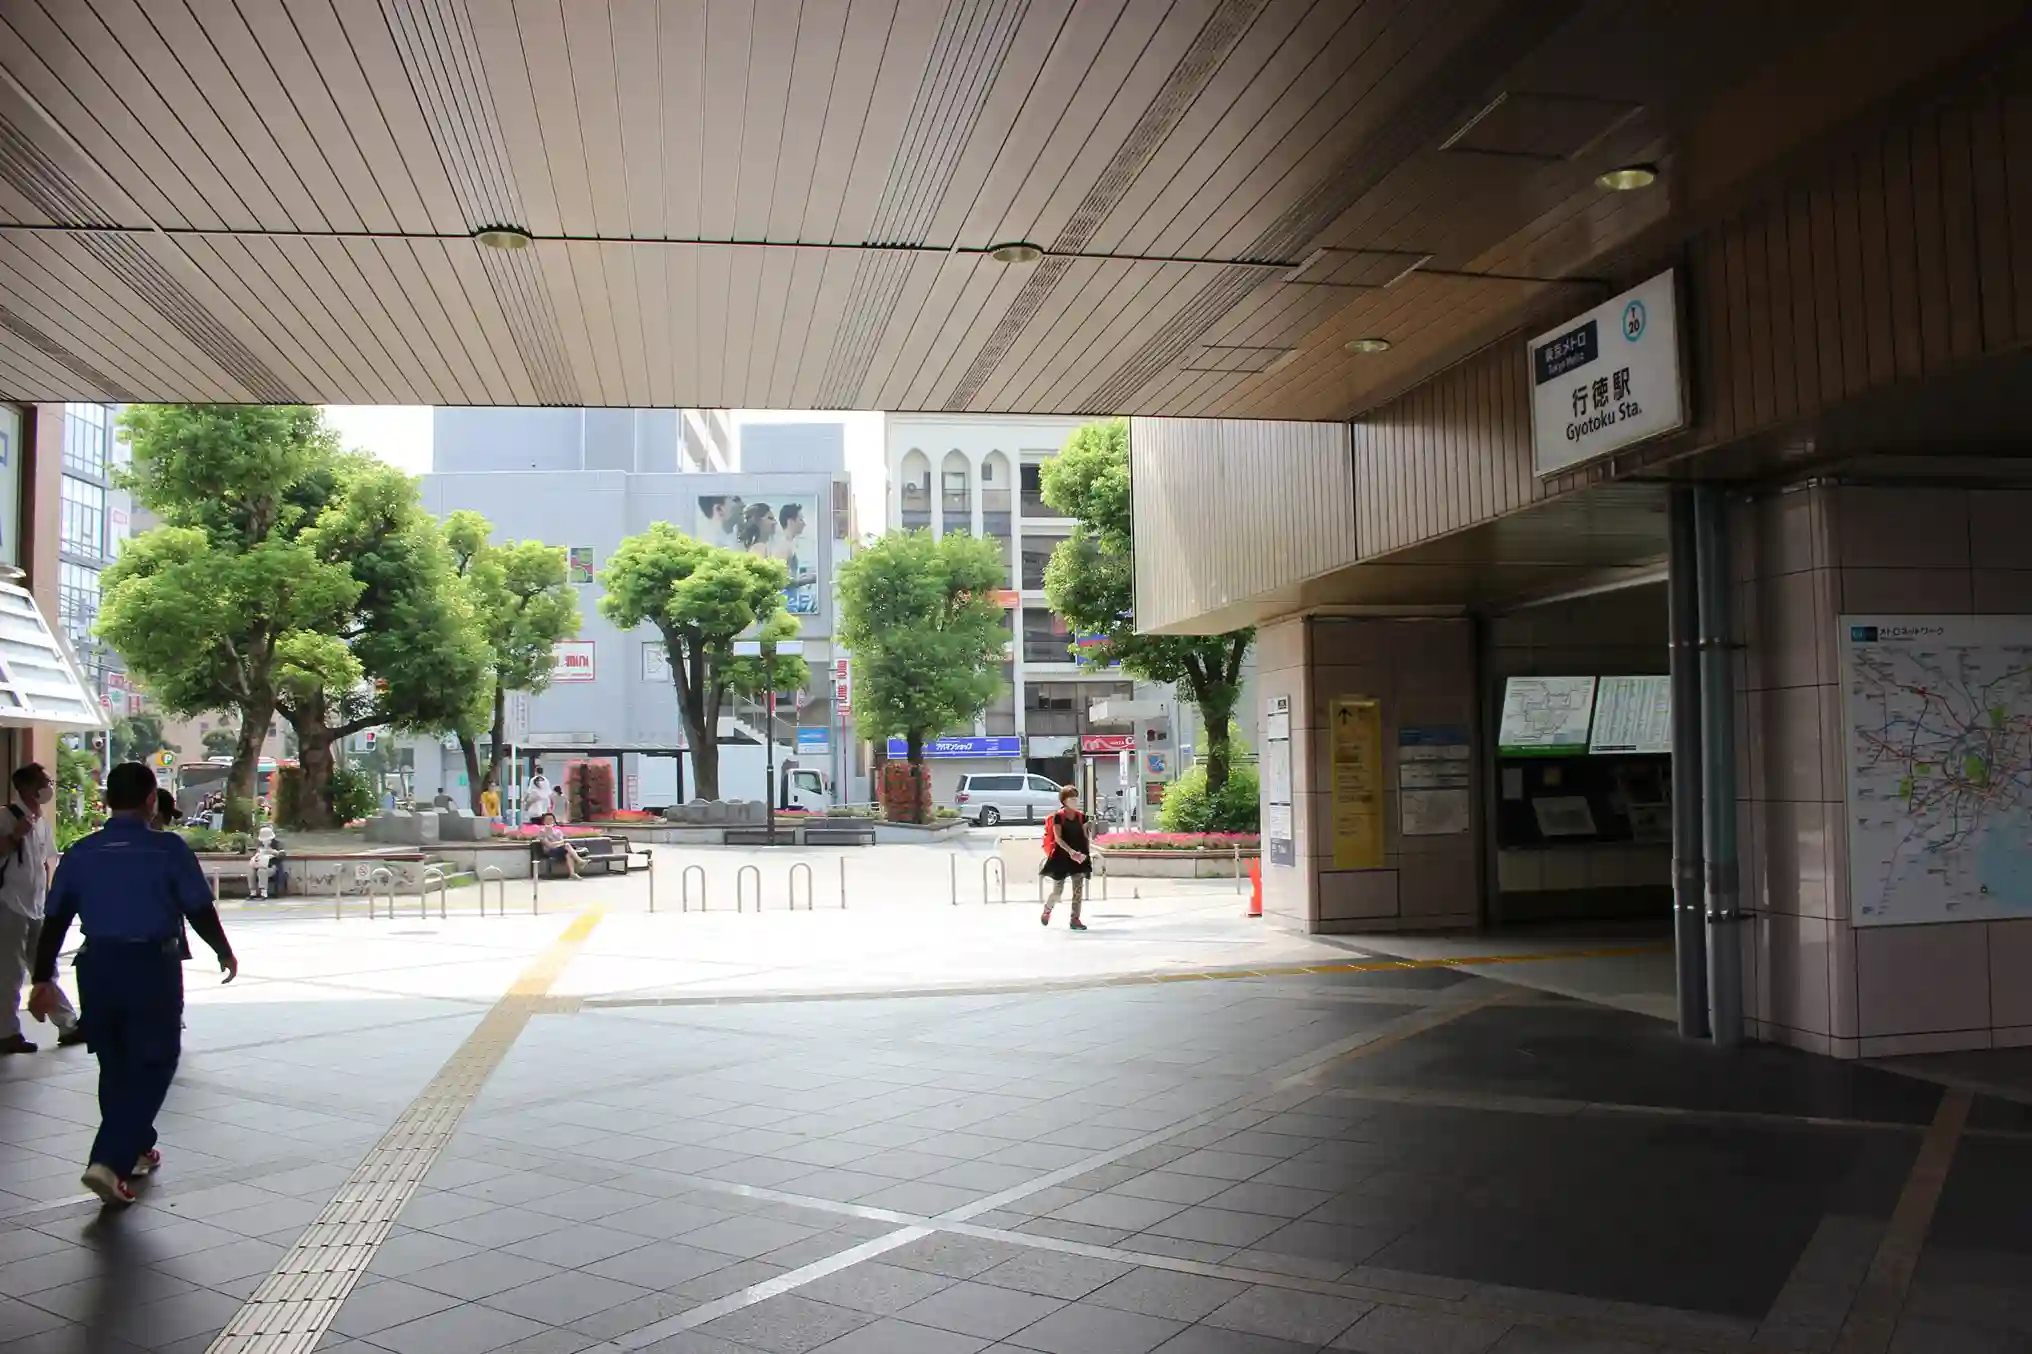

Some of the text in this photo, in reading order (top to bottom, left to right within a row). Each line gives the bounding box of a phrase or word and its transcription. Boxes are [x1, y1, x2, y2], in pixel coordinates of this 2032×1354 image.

[1628, 319, 1640, 335] 20
[1544, 331, 1586, 363] 東京メトロ
[1572, 367, 1631, 418] 行徳駅
[1566, 401, 1642, 442] Gyotoku Sta.
[1879, 627, 1944, 636] メトロネットワーク
